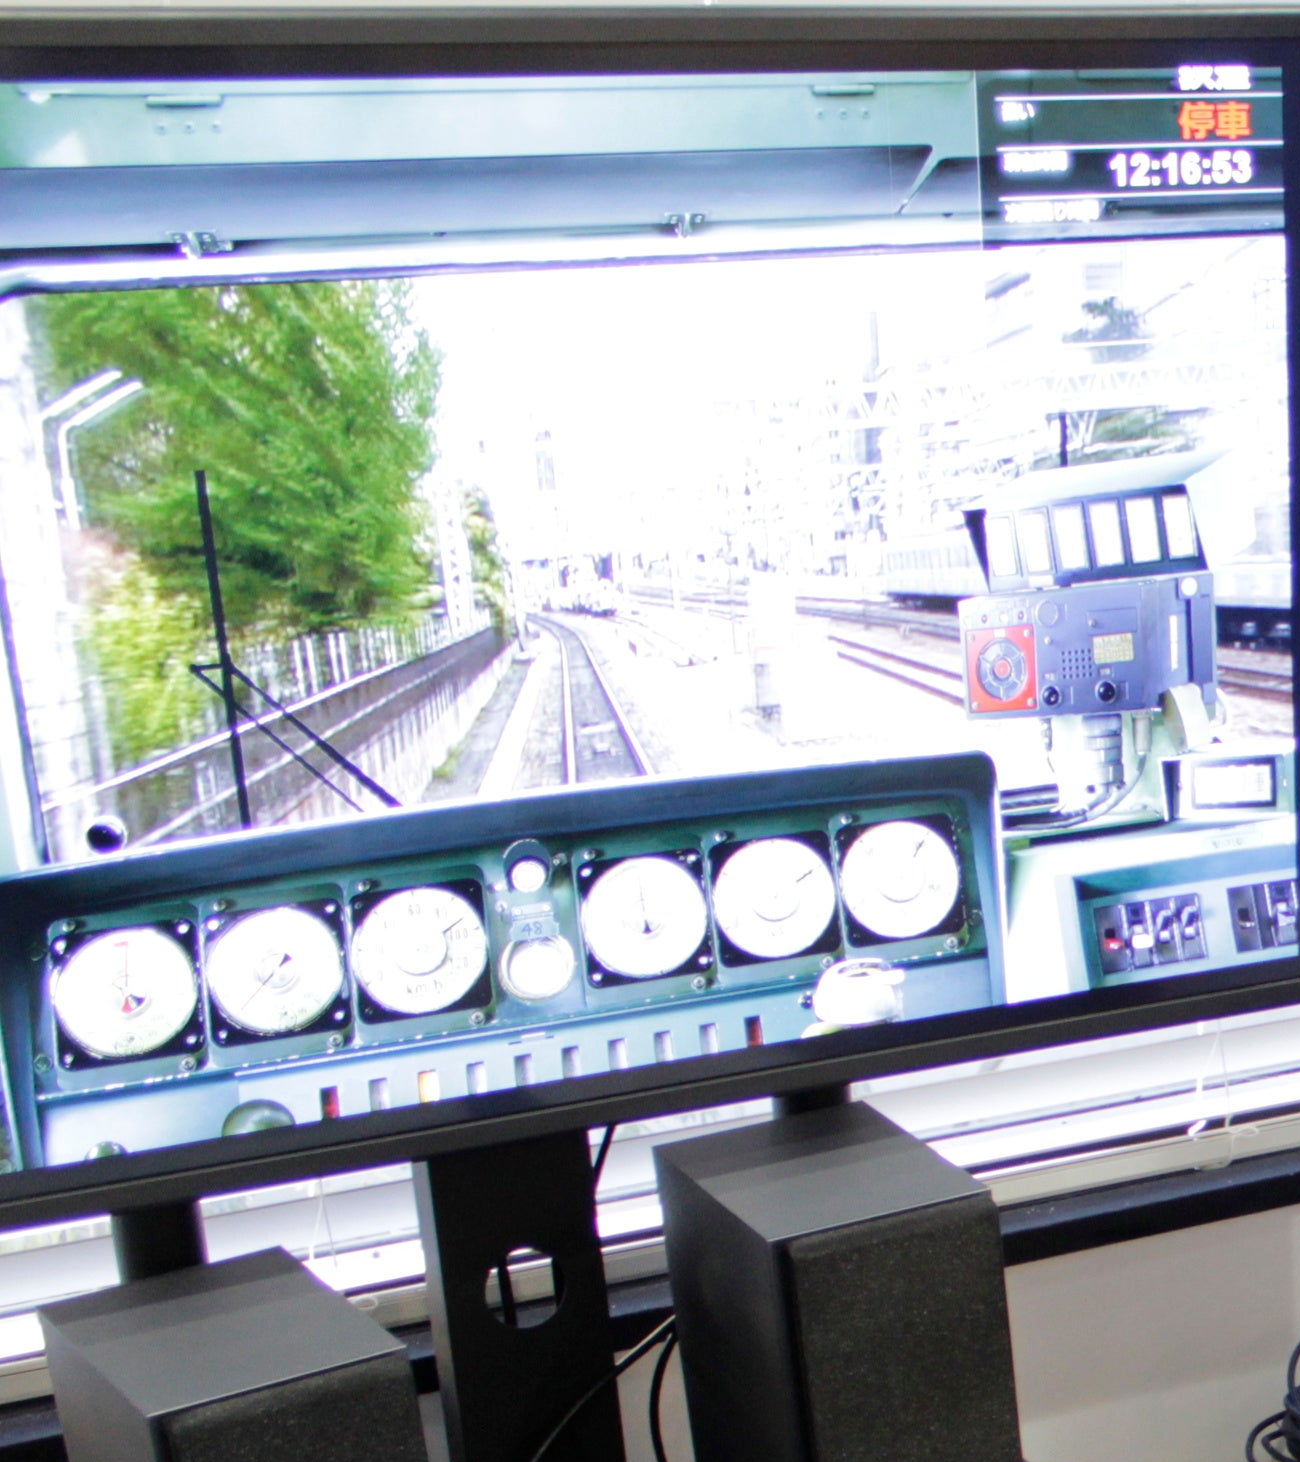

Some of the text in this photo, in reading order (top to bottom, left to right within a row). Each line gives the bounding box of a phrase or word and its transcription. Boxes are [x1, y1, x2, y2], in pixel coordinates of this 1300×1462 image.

[1177, 101, 1252, 140] 停車
[1109, 150, 1253, 187] 12:16:53
[521, 920, 545, 937] 48
